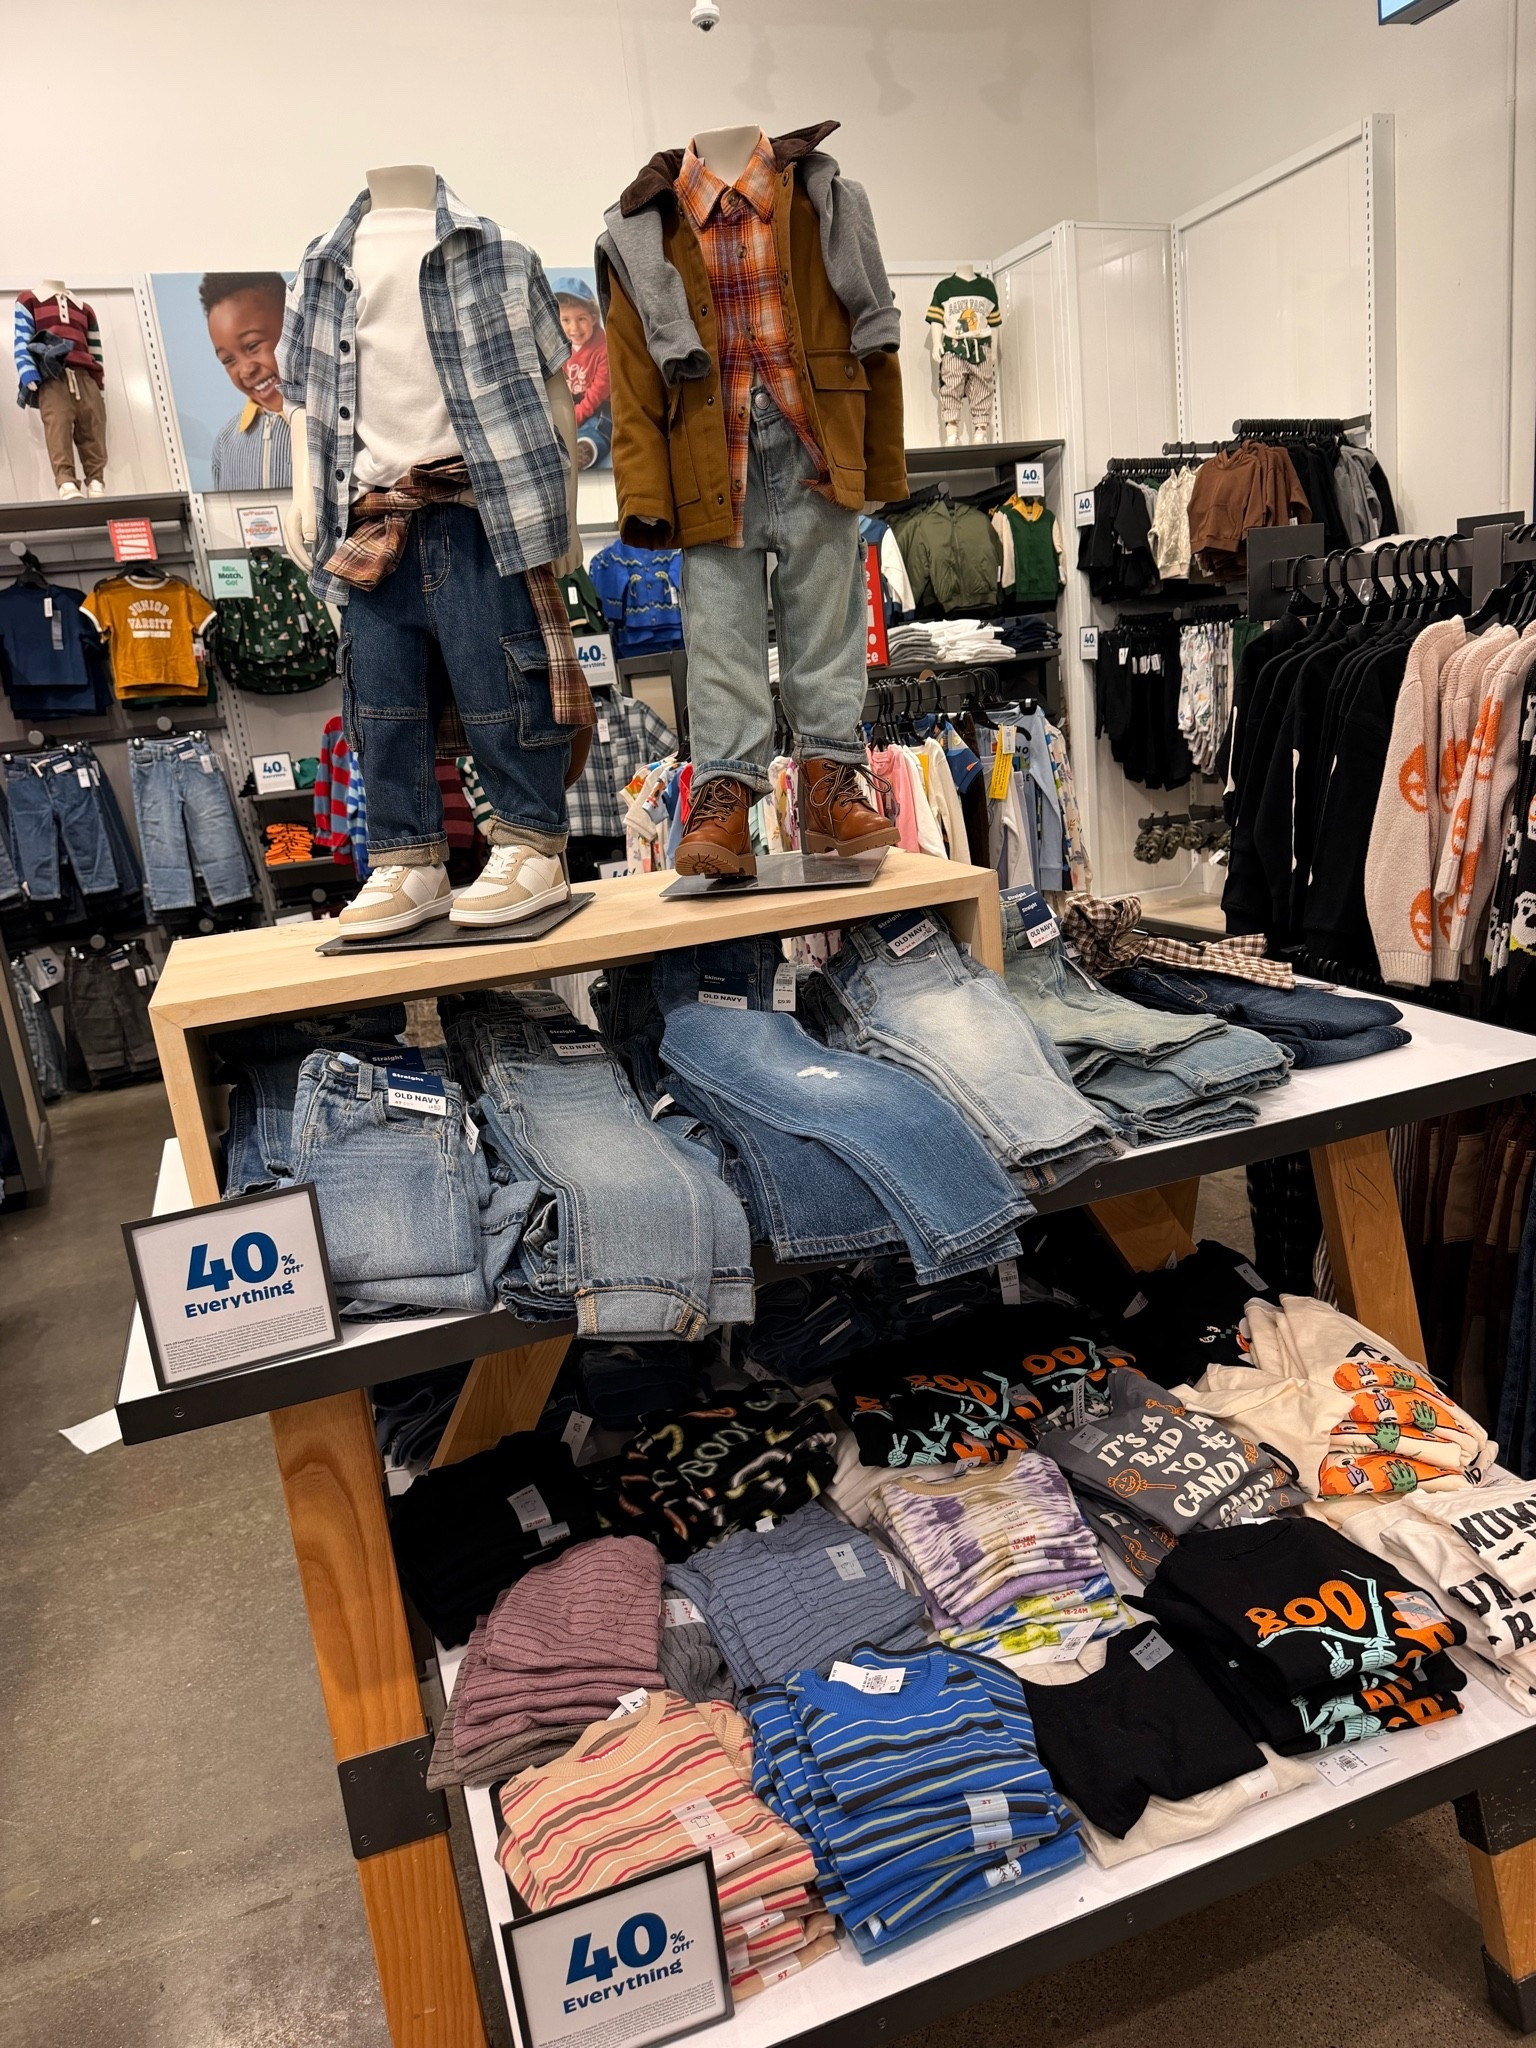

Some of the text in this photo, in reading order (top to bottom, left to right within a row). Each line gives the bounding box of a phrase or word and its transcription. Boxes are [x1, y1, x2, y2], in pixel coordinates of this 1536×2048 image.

[1023, 469, 1037, 480] 40
[1079, 498, 1090, 509] 40
[128, 600, 170, 617] JUNIOR
[127, 618, 173, 630] VARSITY
[1084, 633, 1094, 643] 40
[578, 645, 601, 662] 40
[263, 761, 282, 774] 40
[1022, 902, 1038, 913] Straight
[877, 912, 902, 929] Straight
[894, 923, 927, 947] OLD NAVY
[1030, 922, 1053, 938] OLD NAVY
[41, 958, 57, 975] 40
[704, 974, 726, 982] Skinny
[392, 1072, 424, 1082] Straight
[394, 1092, 440, 1105] OLD NAVY
[186, 1232, 279, 1292] 40
[281, 1253, 296, 1266] %
[184, 1279, 295, 1318] Everything
[1097, 1432, 1148, 1468] IT'S
[1141, 1414, 1164, 1435] A
[1129, 1427, 1183, 1468] BAD
[1161, 1452, 1207, 1476] TO
[1173, 1451, 1249, 1518] CANDY
[1012, 1540, 1037, 1550] 18-24M
[1052, 1589, 1076, 1602] 18-24M
[1063, 1608, 1089, 1616] 18-24M
[1245, 1580, 1366, 1640] BOO
[1135, 1642, 1151, 1656] 12-18
[1259, 1791, 1268, 1799] 4T
[706, 1832, 716, 1840] 3T
[987, 1841, 997, 1850] 3T
[1019, 1844, 1028, 1853] 4T
[724, 1851, 736, 1861] 3T
[670, 1930, 685, 1945] %
[565, 1912, 667, 1985] 40
[778, 1970, 789, 1980] 5T
[563, 1958, 684, 2014] Everything
